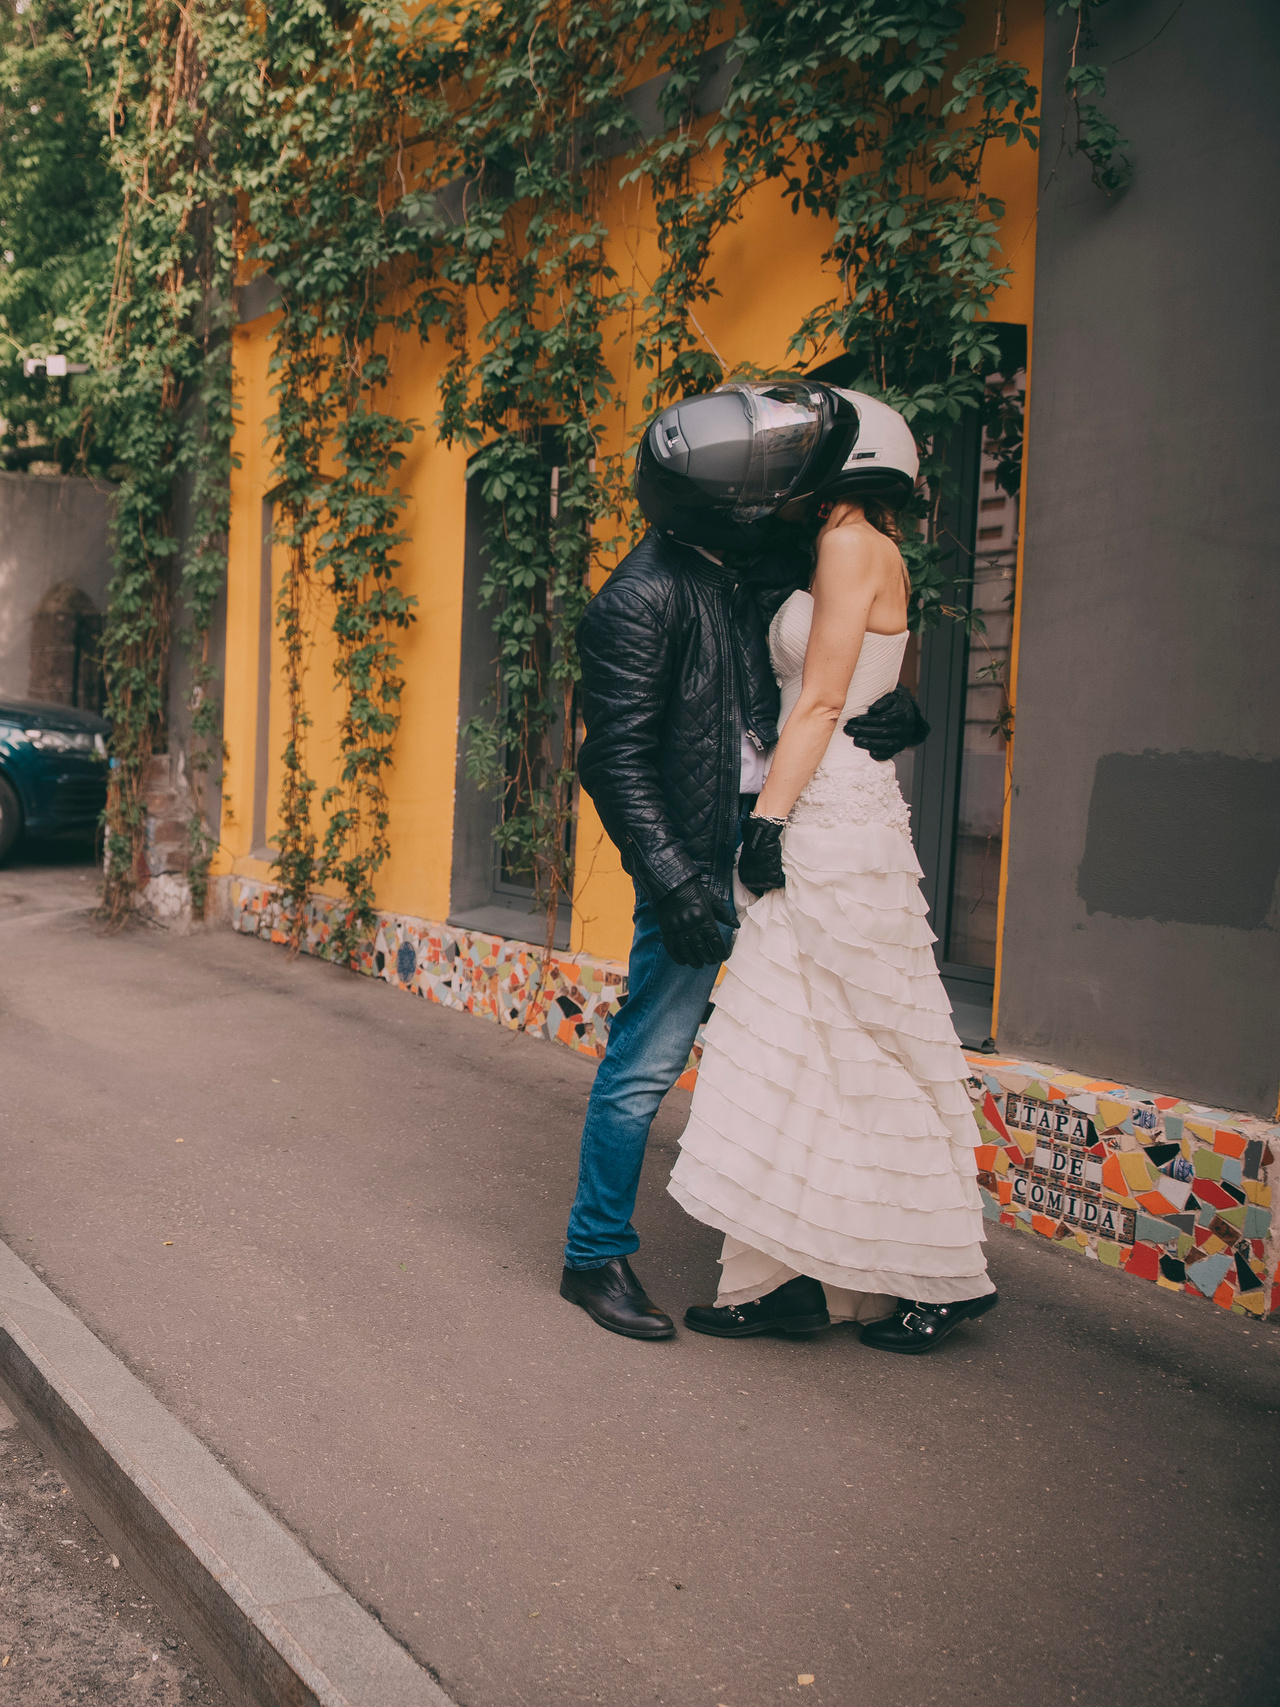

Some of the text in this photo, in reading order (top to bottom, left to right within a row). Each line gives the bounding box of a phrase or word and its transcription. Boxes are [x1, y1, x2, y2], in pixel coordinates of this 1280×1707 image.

[1022, 1105, 1085, 1138] TAPA
[1052, 1152, 1083, 1177] DE
[1014, 1178, 1115, 1230] COMIDA
